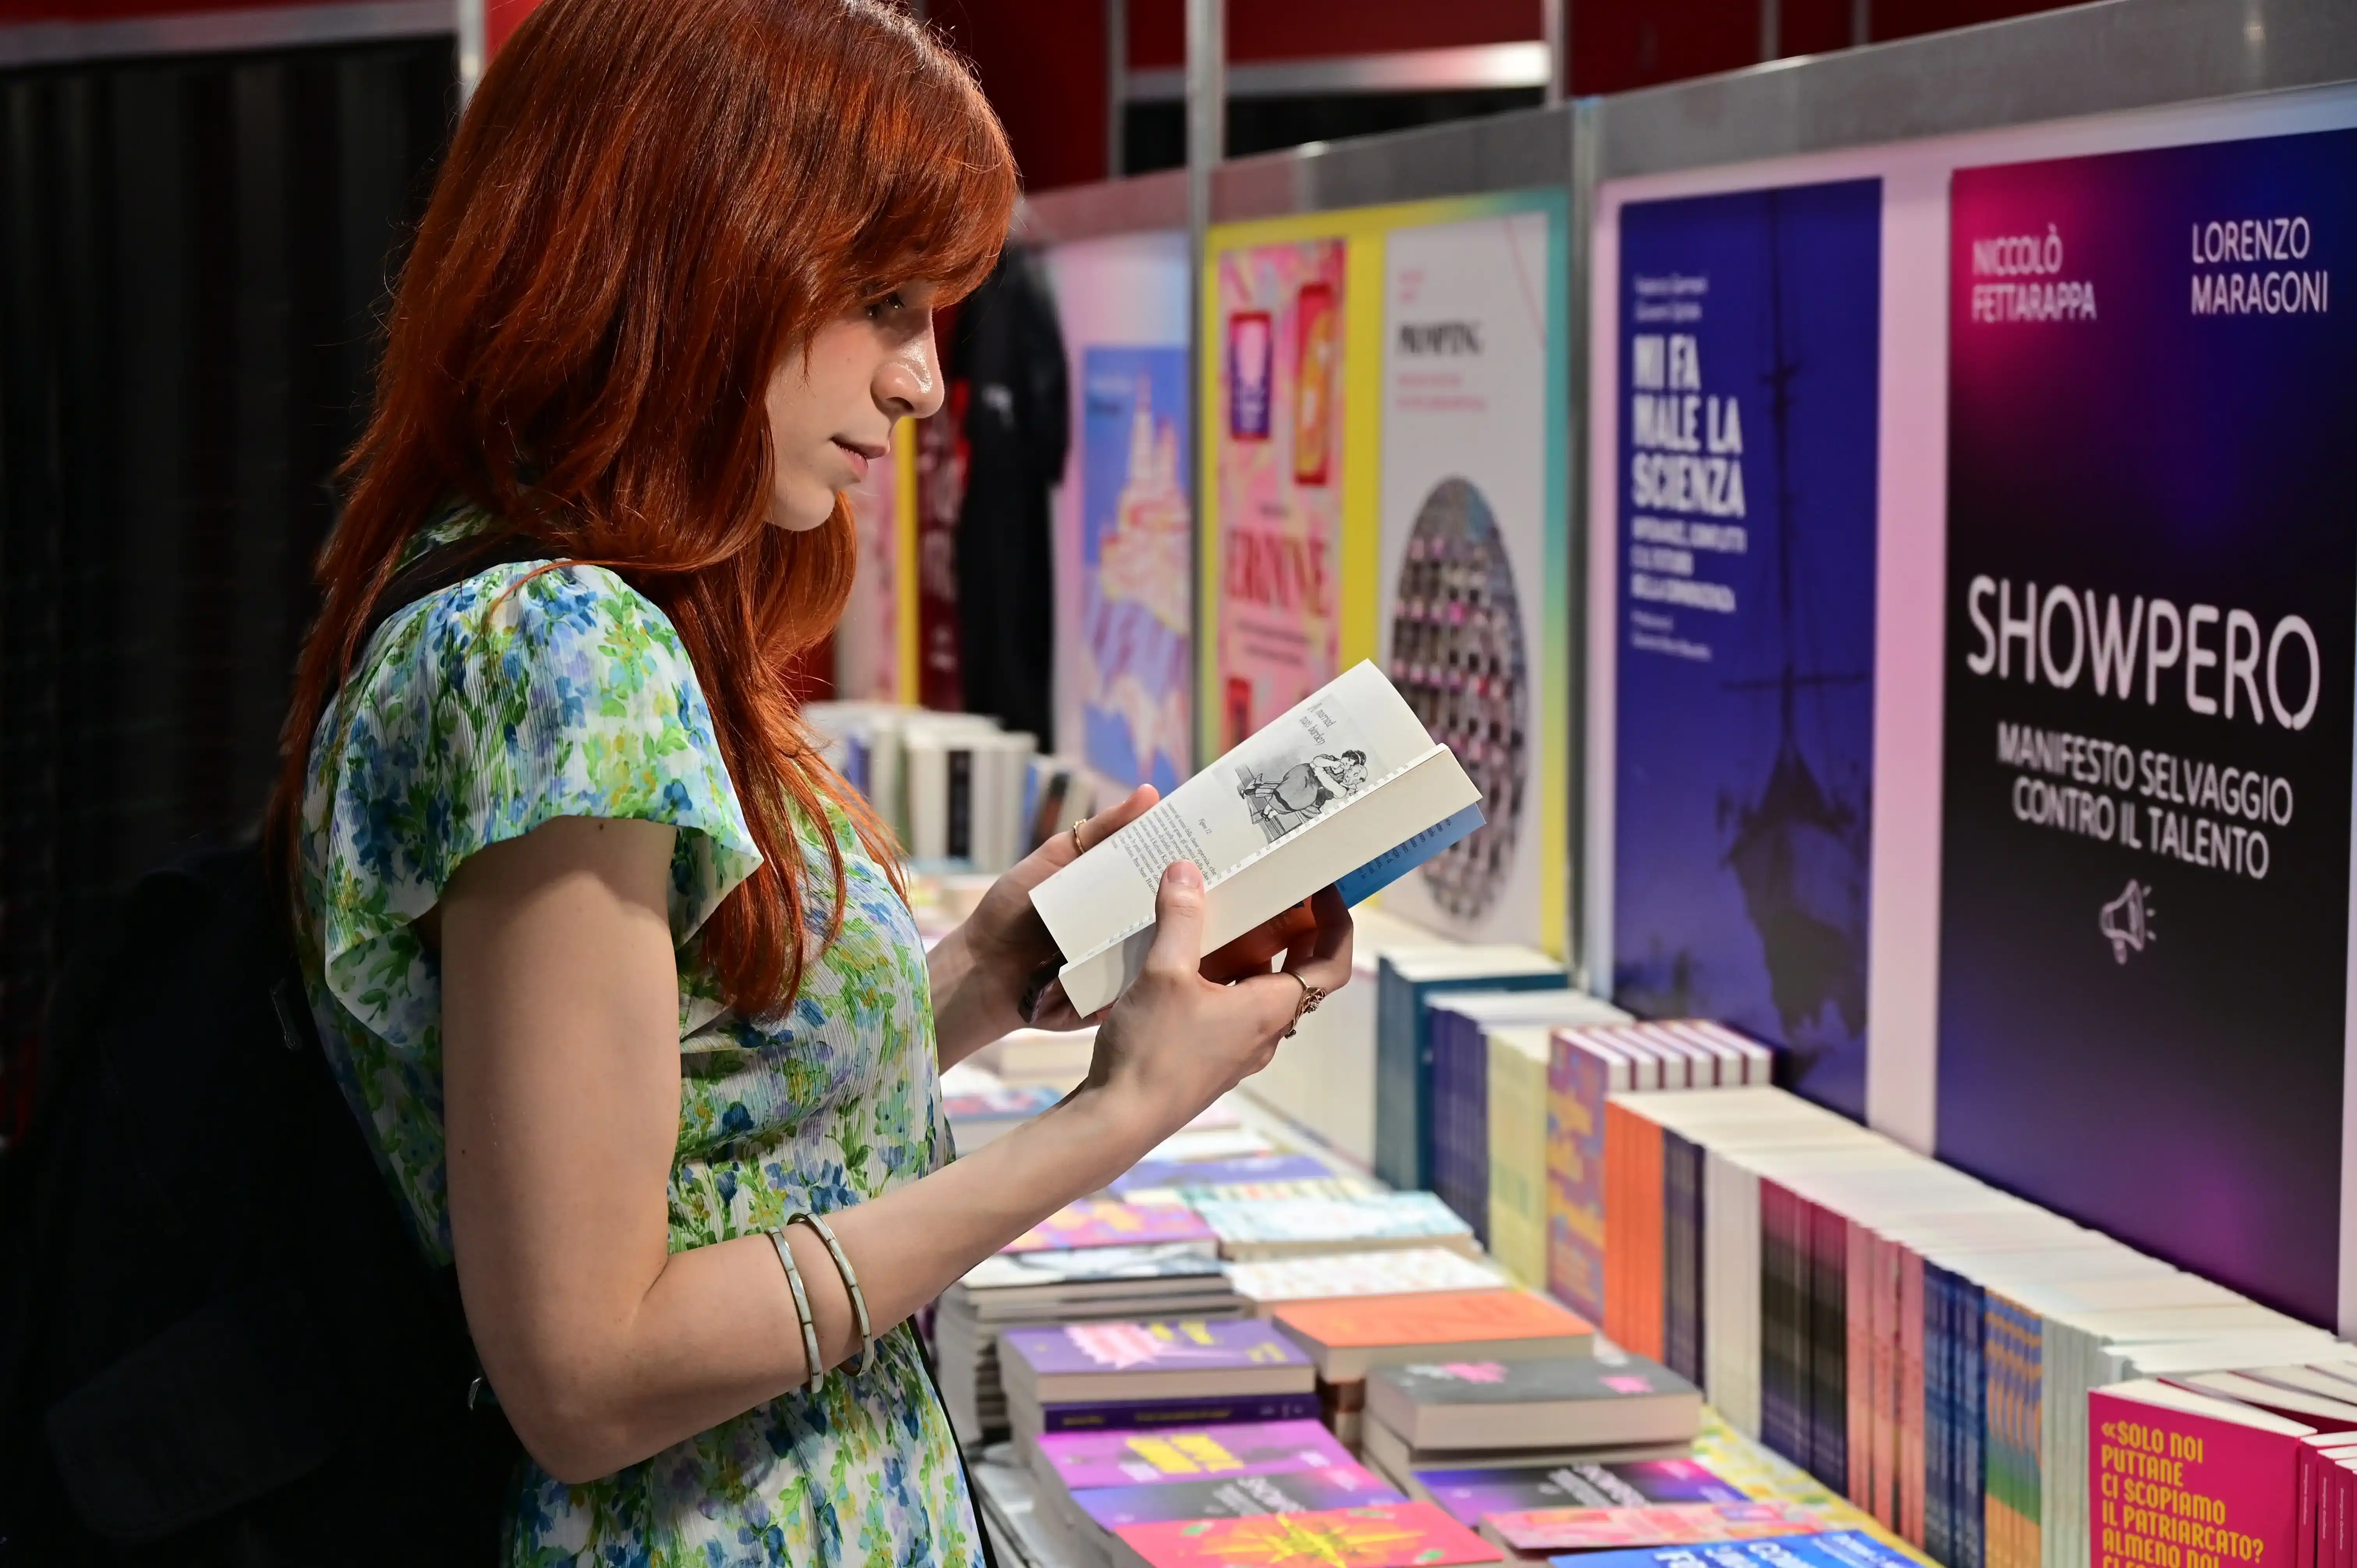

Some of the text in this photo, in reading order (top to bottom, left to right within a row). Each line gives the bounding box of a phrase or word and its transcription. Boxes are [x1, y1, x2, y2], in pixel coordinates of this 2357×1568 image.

[1972, 222, 2063, 275] NICCOLÒ
[2192, 216, 2310, 263] LORENZO
[1972, 280, 2097, 323] FETTARAPPA
[2191, 270, 2328, 315] MARAGONI
[1668, 332, 1701, 391] FA
[1632, 394, 1743, 455] MALE LA
[1967, 575, 2320, 730] SHOWPERO
[1308, 724, 1325, 746] burden
[1997, 721, 2293, 826] MANIFESTO SELVAGGIO
[1170, 839, 1185, 855] presenti
[2012, 775, 2270, 879] CONTRO IL TALENTO
[1139, 867, 1147, 878] State
[1184, 844, 1197, 859] uomini
[1194, 859, 1203, 871] della
[1197, 849, 1210, 867] operaia,
[1209, 867, 1217, 876] che
[2101, 1420, 2203, 1464] «SOLO NOI
[2101, 1444, 2184, 1487] PUTTANE
[2101, 1472, 2226, 1526] CI SCOPIAMO
[2102, 1499, 2264, 1564] IL PATRIARCATO?
[2102, 1527, 2181, 1568] ALMENO
